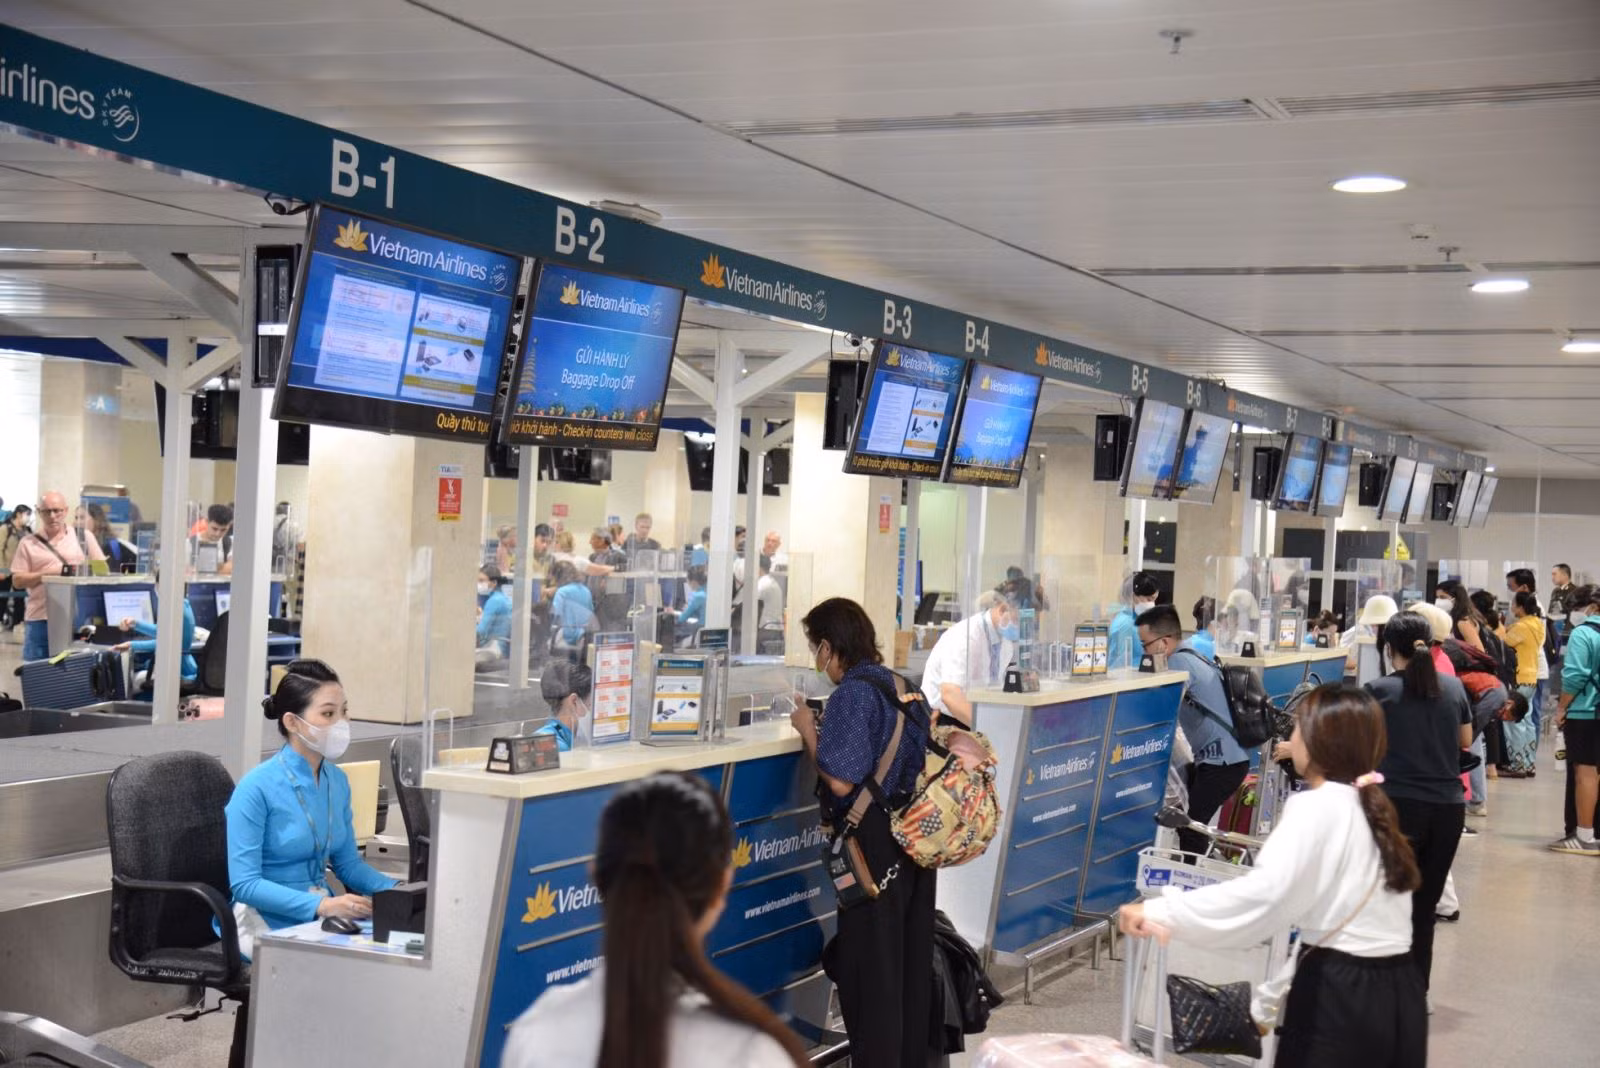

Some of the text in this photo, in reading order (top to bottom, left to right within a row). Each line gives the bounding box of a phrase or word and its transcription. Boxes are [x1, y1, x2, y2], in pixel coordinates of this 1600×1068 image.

[331, 138, 396, 208] B-1
[555, 205, 606, 264] B-2
[883, 299, 912, 339] B-3
[965, 320, 990, 356] B-4
[561, 368, 636, 392] Baggage Drop Off
[1131, 365, 1149, 394] B-5
[1187, 380, 1202, 407] B-6
[437, 412, 460, 433] Quầy
[461, 416, 477, 431] thủ
[563, 423, 593, 439] Check-in
[593, 427, 624, 440] counters
[624, 428, 636, 440] will
